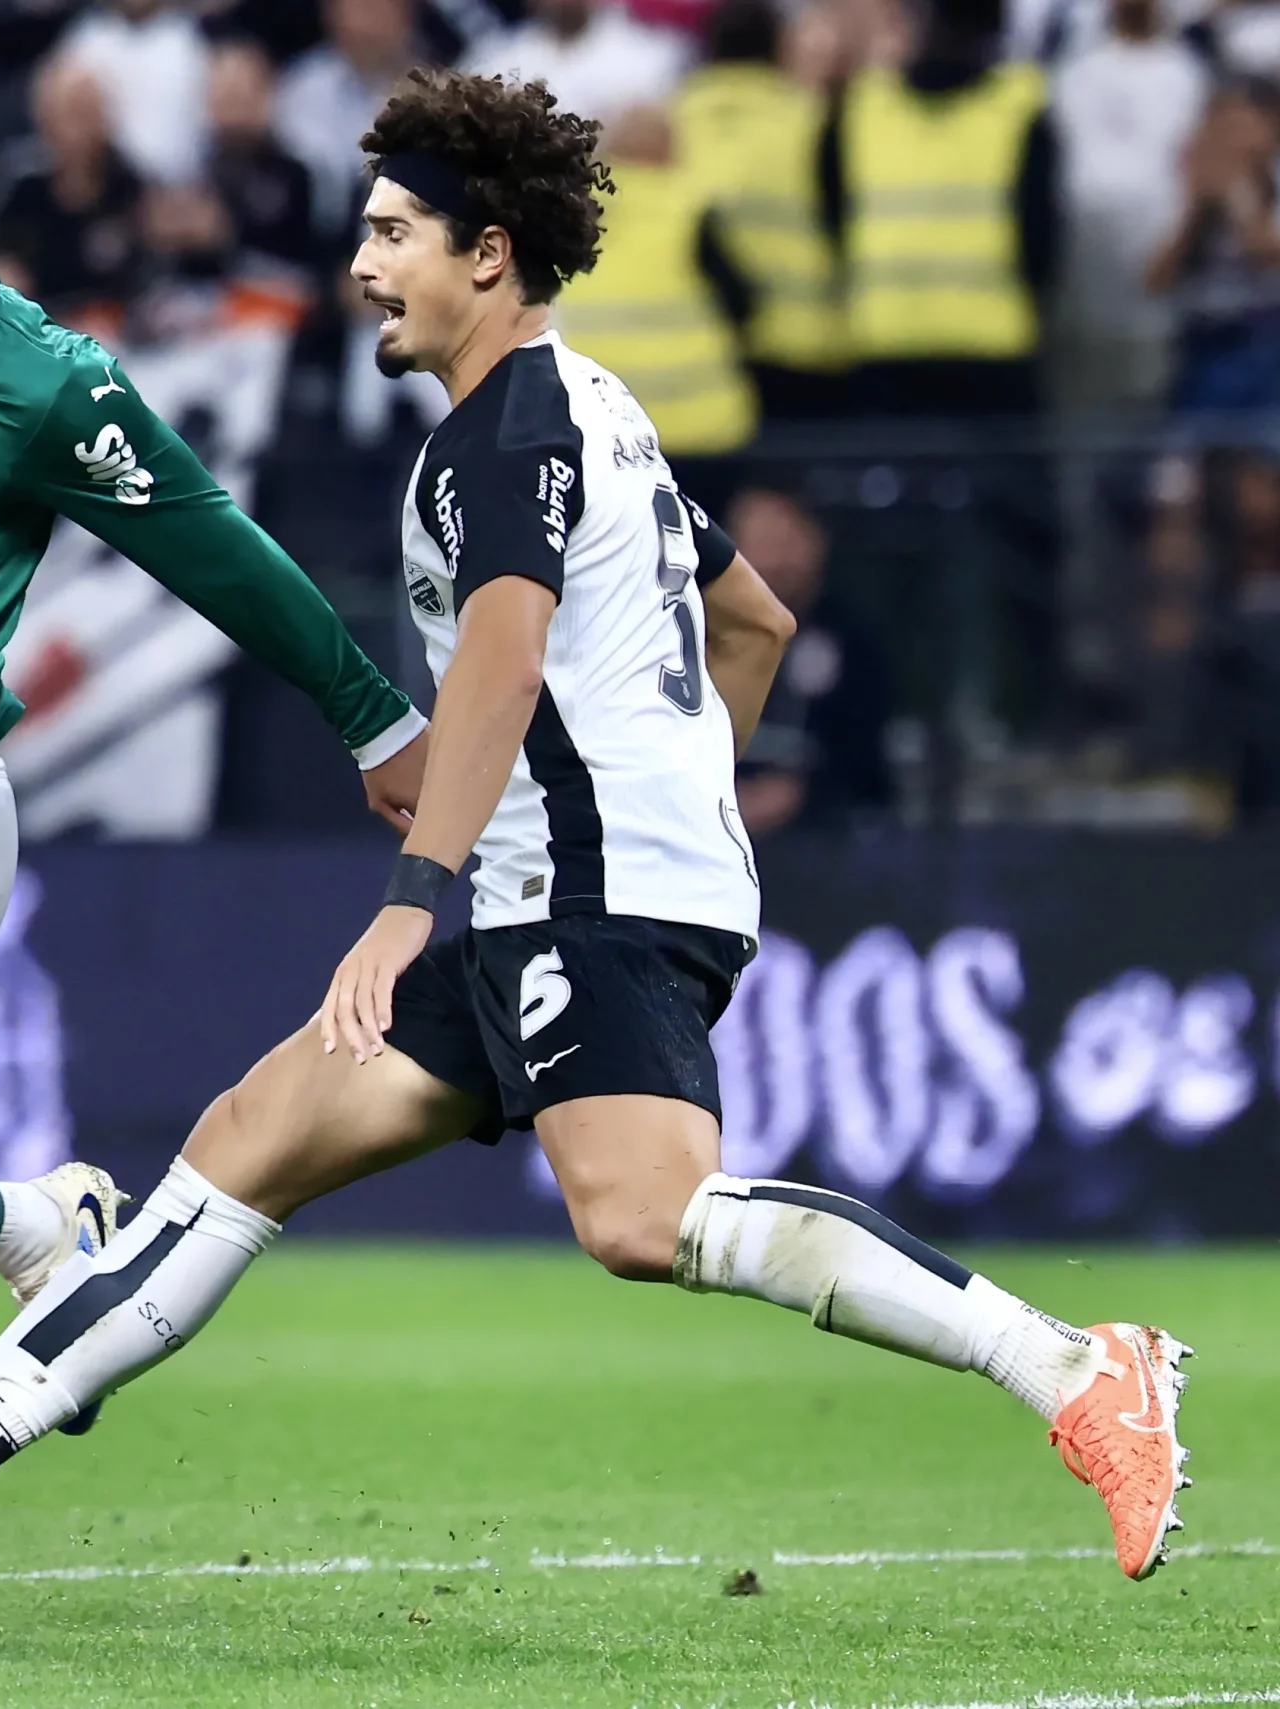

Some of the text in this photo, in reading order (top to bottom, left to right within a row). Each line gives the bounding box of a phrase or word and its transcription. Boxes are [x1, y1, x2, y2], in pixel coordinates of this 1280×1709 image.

[536, 464, 549, 501] banco
[542, 456, 575, 535] bmg
[651, 482, 705, 717] 5
[519, 945, 571, 1042] 5
